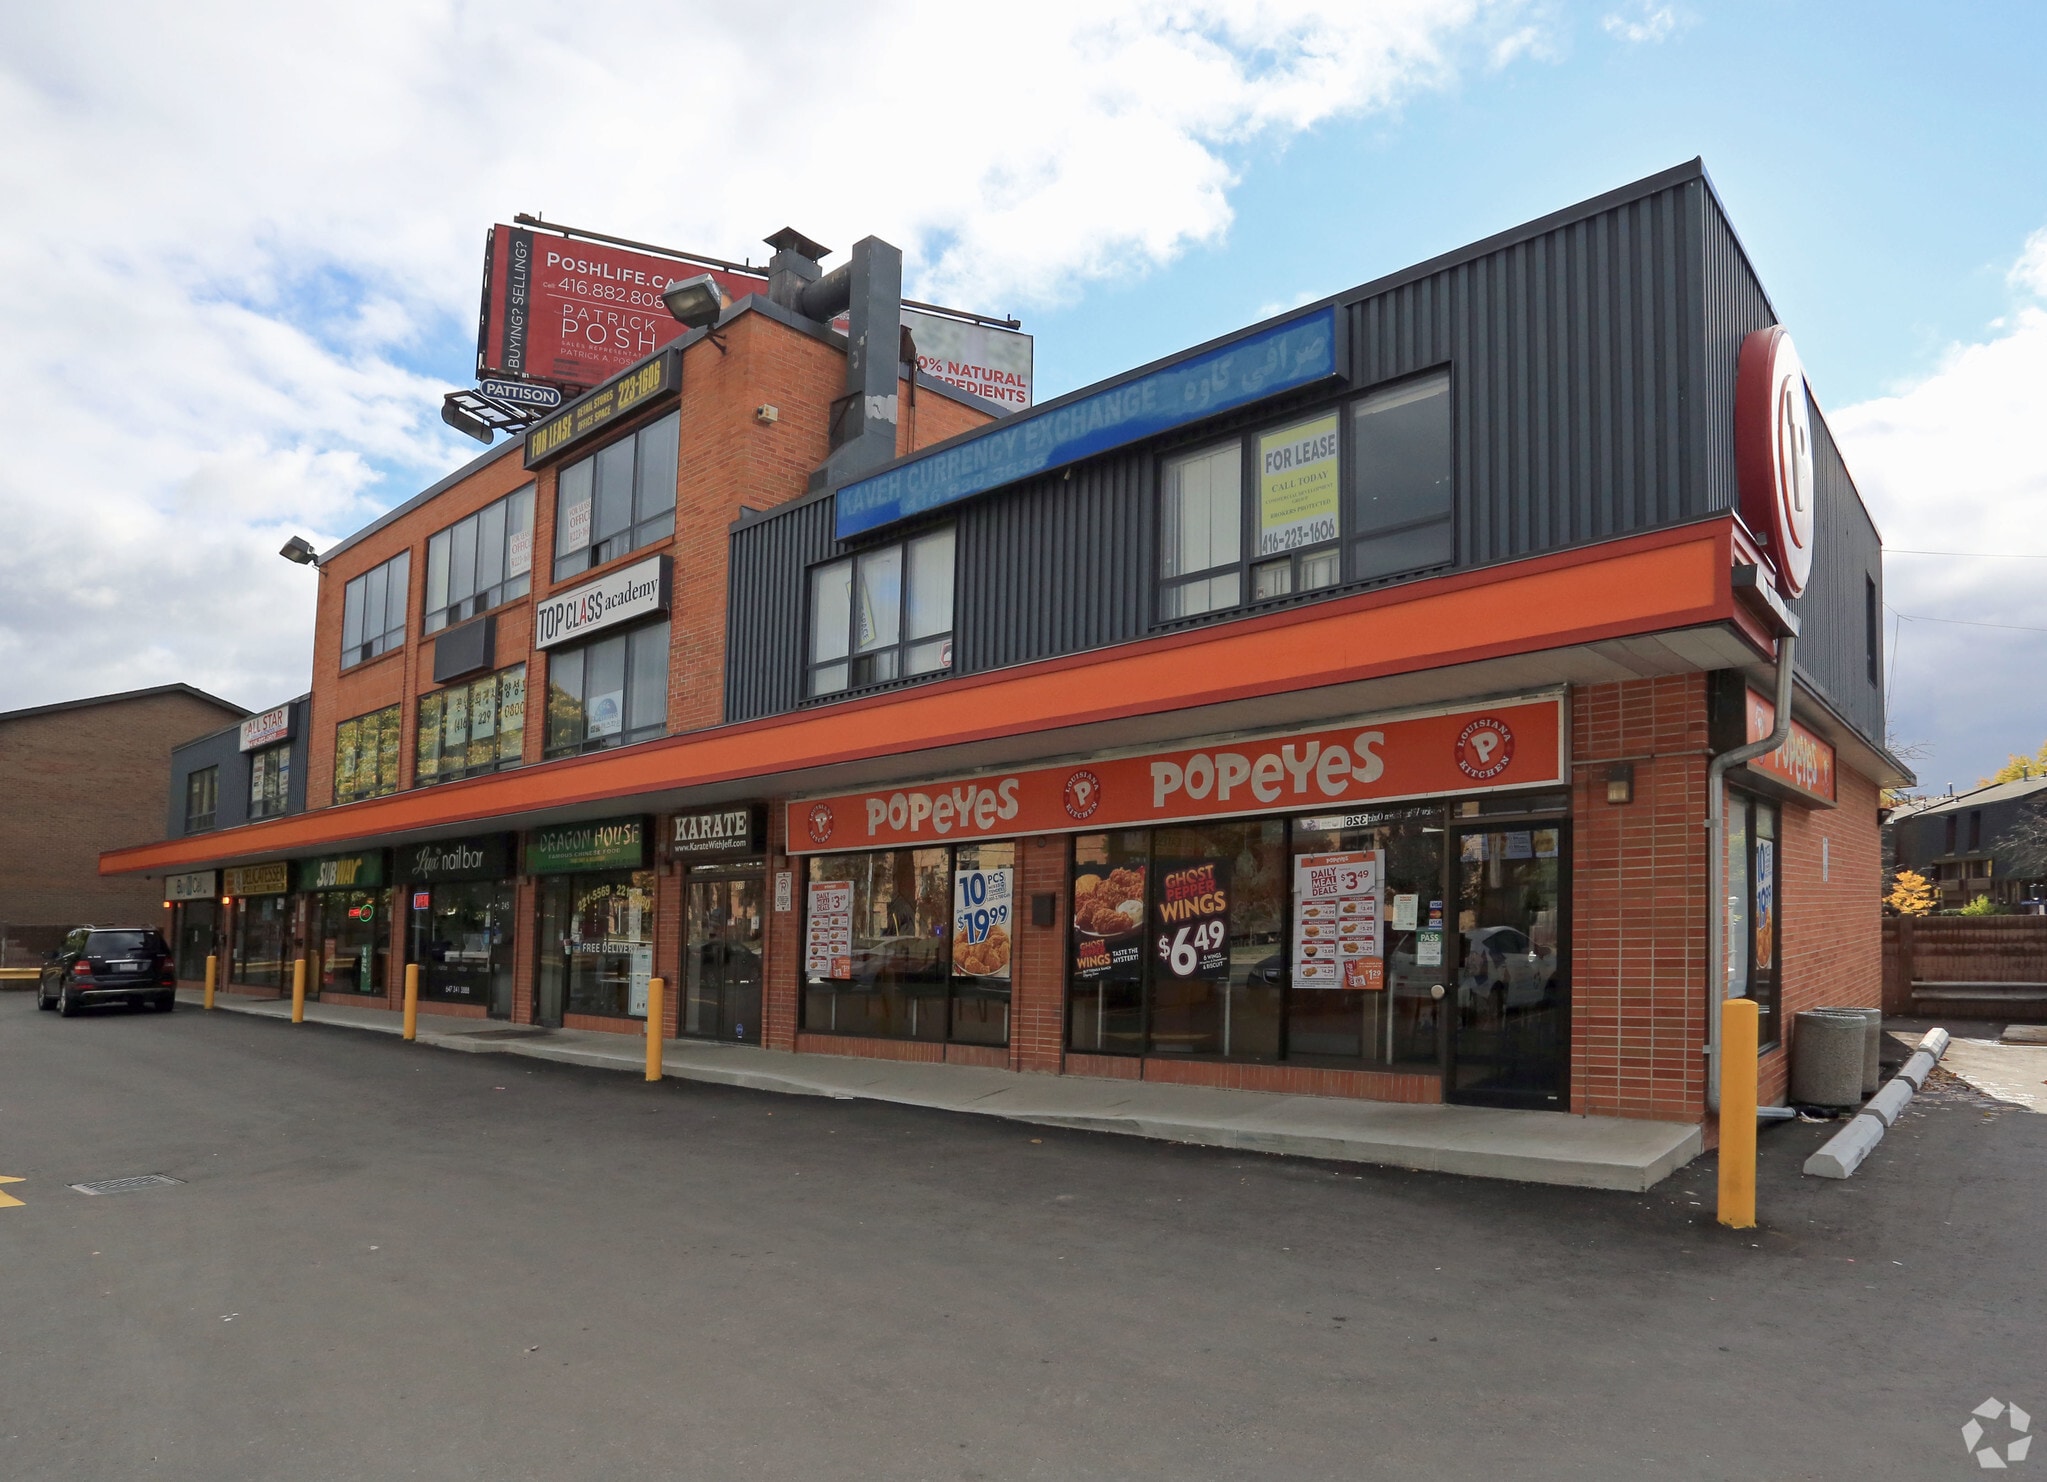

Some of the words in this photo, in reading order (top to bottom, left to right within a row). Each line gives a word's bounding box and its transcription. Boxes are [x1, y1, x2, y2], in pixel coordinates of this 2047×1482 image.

[512, 241, 528, 305] SELLING?
[562, 304, 656, 332] PATRICK
[508, 309, 524, 369] BUYING?
[562, 318, 656, 353] POSH
[560, 347, 599, 361] PATRICK
[948, 361, 1026, 388] NATURAL
[486, 383, 555, 404] PATTISON
[532, 428, 546, 459] FOR
[549, 414, 573, 449] LEASE
[907, 431, 1018, 493] CURRENCY
[1026, 380, 1156, 449] EXCHANGE
[1265, 447, 1292, 474] FOR
[1296, 434, 1336, 465] LEASE
[1272, 480, 1296, 493] CALL
[1298, 470, 1329, 486] TODAY
[1297, 499, 1331, 513] PROTECTED
[1263, 518, 1335, 554] 416-223-1606
[539, 602, 564, 642] TOP
[566, 591, 603, 630] CLASS
[605, 577, 658, 611] academy
[248, 722, 260, 734] ALL
[263, 710, 283, 730] STAR
[478, 710, 492, 725] 229
[1457, 719, 1511, 748] LOUISIANA
[1459, 754, 1510, 779] KITCHEN
[1065, 771, 1099, 793] LOUISIANA
[1066, 801, 1097, 819] KITCHEN
[594, 823, 640, 847] HOUSE
[675, 811, 747, 841] KARATE
[675, 839, 747, 852] www.KarateWithJeff.com
[317, 858, 362, 887] SUBWAY
[1165, 864, 1214, 889] GHOST
[1311, 867, 1337, 879] DAILY
[1312, 876, 1338, 889] MEAL
[959, 872, 986, 908] 10
[988, 871, 1004, 885] PCS
[1167, 880, 1216, 901] PEPPER
[1312, 886, 1338, 896] DEALS
[1160, 891, 1226, 922] WINGS
[582, 943, 600, 953] FREE
[602, 943, 638, 953] DELIVERY
[1112, 949, 1127, 957] TASTE
[1076, 953, 1111, 969] WINGS
